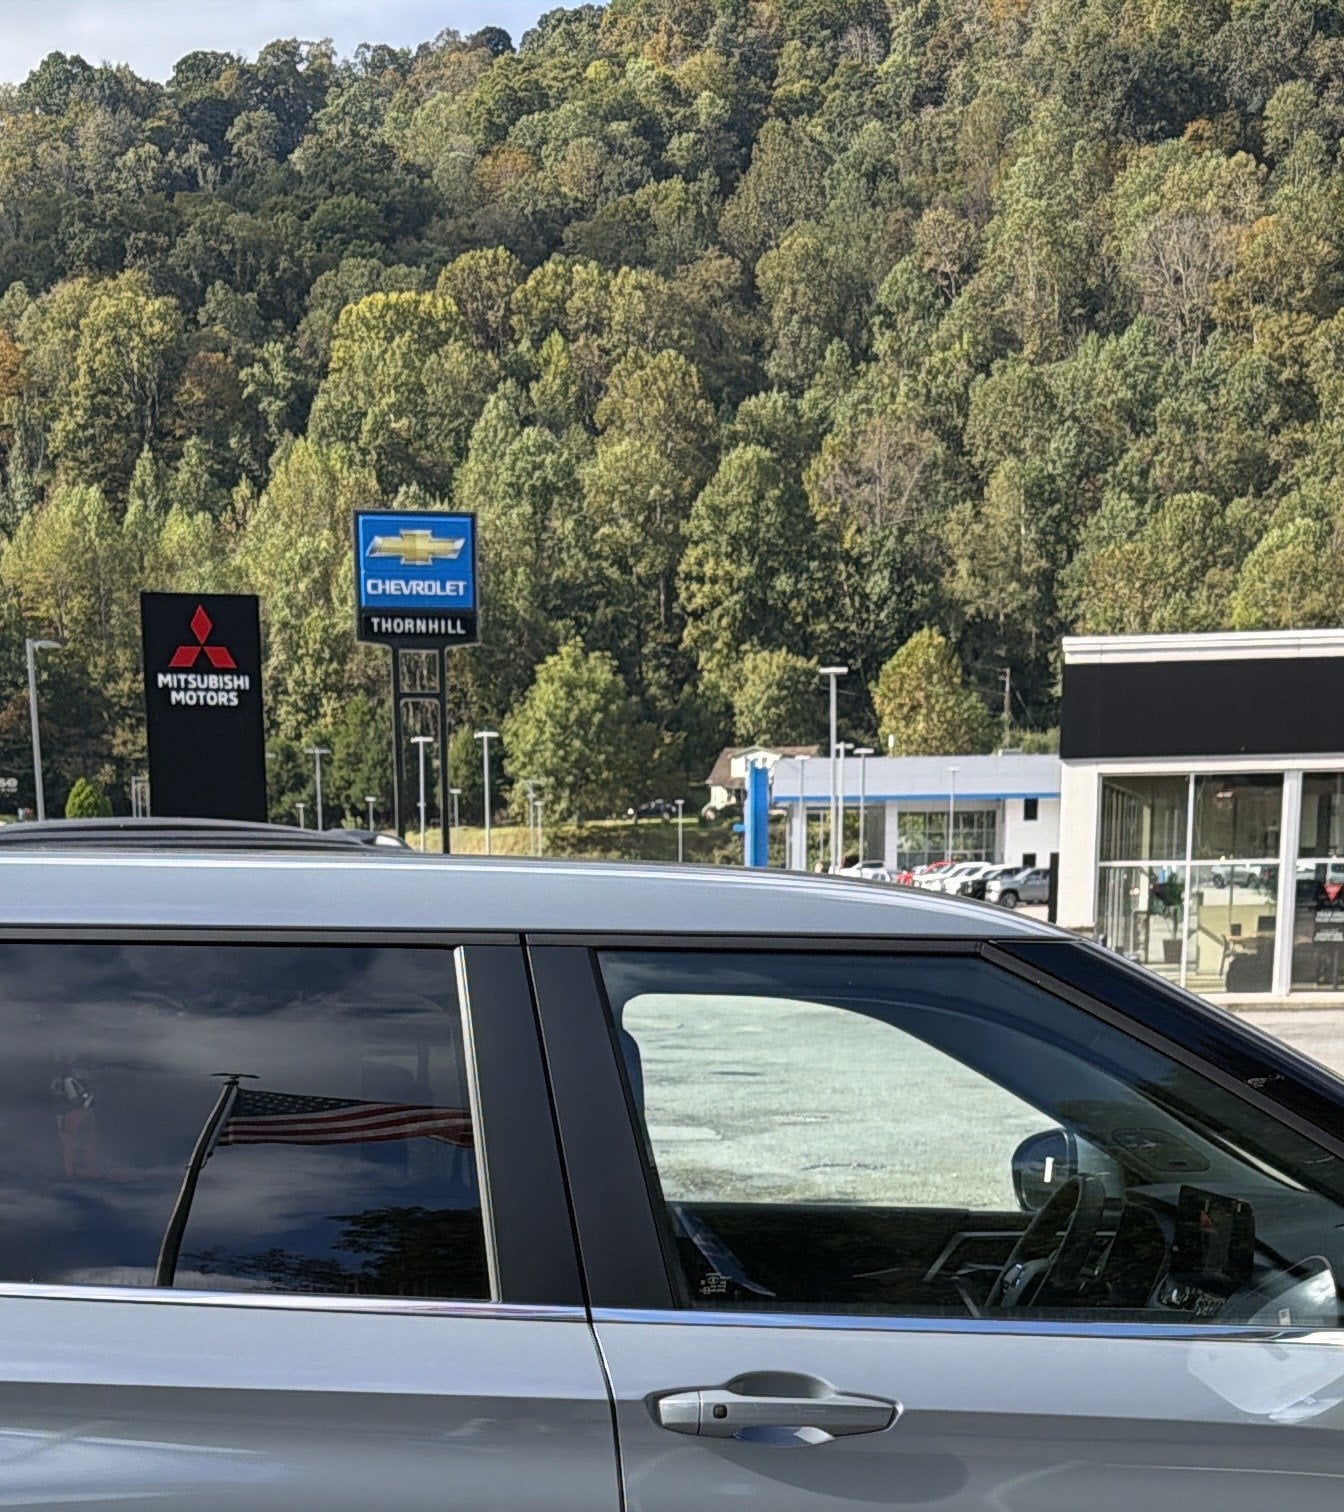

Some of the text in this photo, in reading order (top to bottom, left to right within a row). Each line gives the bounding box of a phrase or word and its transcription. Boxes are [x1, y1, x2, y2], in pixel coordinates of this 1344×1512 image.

[366, 579, 467, 596] CHEVROLET
[370, 617, 467, 635] THORNHILL
[157, 672, 250, 691] MITSUBISHI
[170, 690, 239, 706] MOTORS
